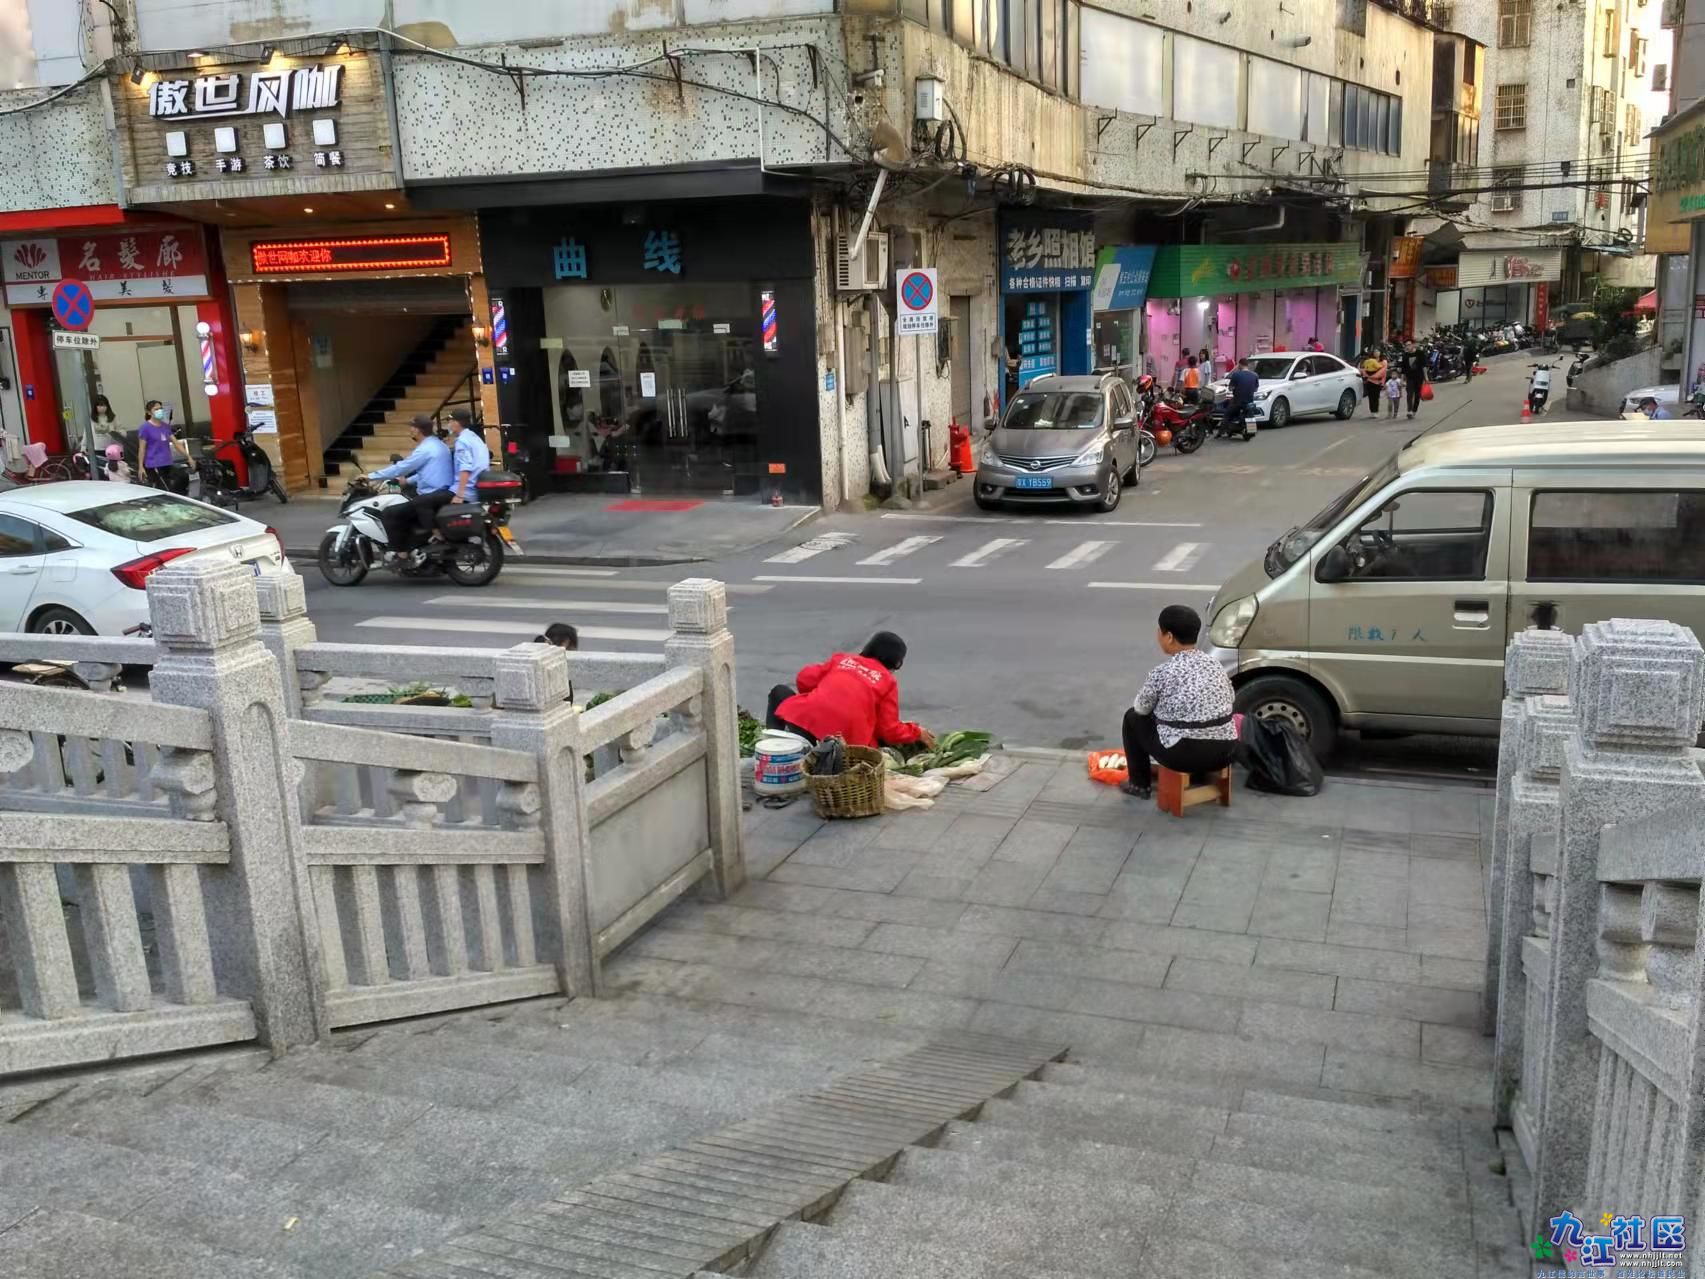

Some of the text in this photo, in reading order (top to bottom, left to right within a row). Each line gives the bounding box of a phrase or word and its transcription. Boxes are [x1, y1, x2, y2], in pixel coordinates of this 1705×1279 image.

[166, 151, 340, 176] 竞技 手游 茶饮 简餐
[553, 231, 681, 280] 曲线
[1008, 228, 1095, 269] 老乡照相馆
[16, 271, 50, 281] MENTOR
[56, 335, 97, 346] 停车位除外
